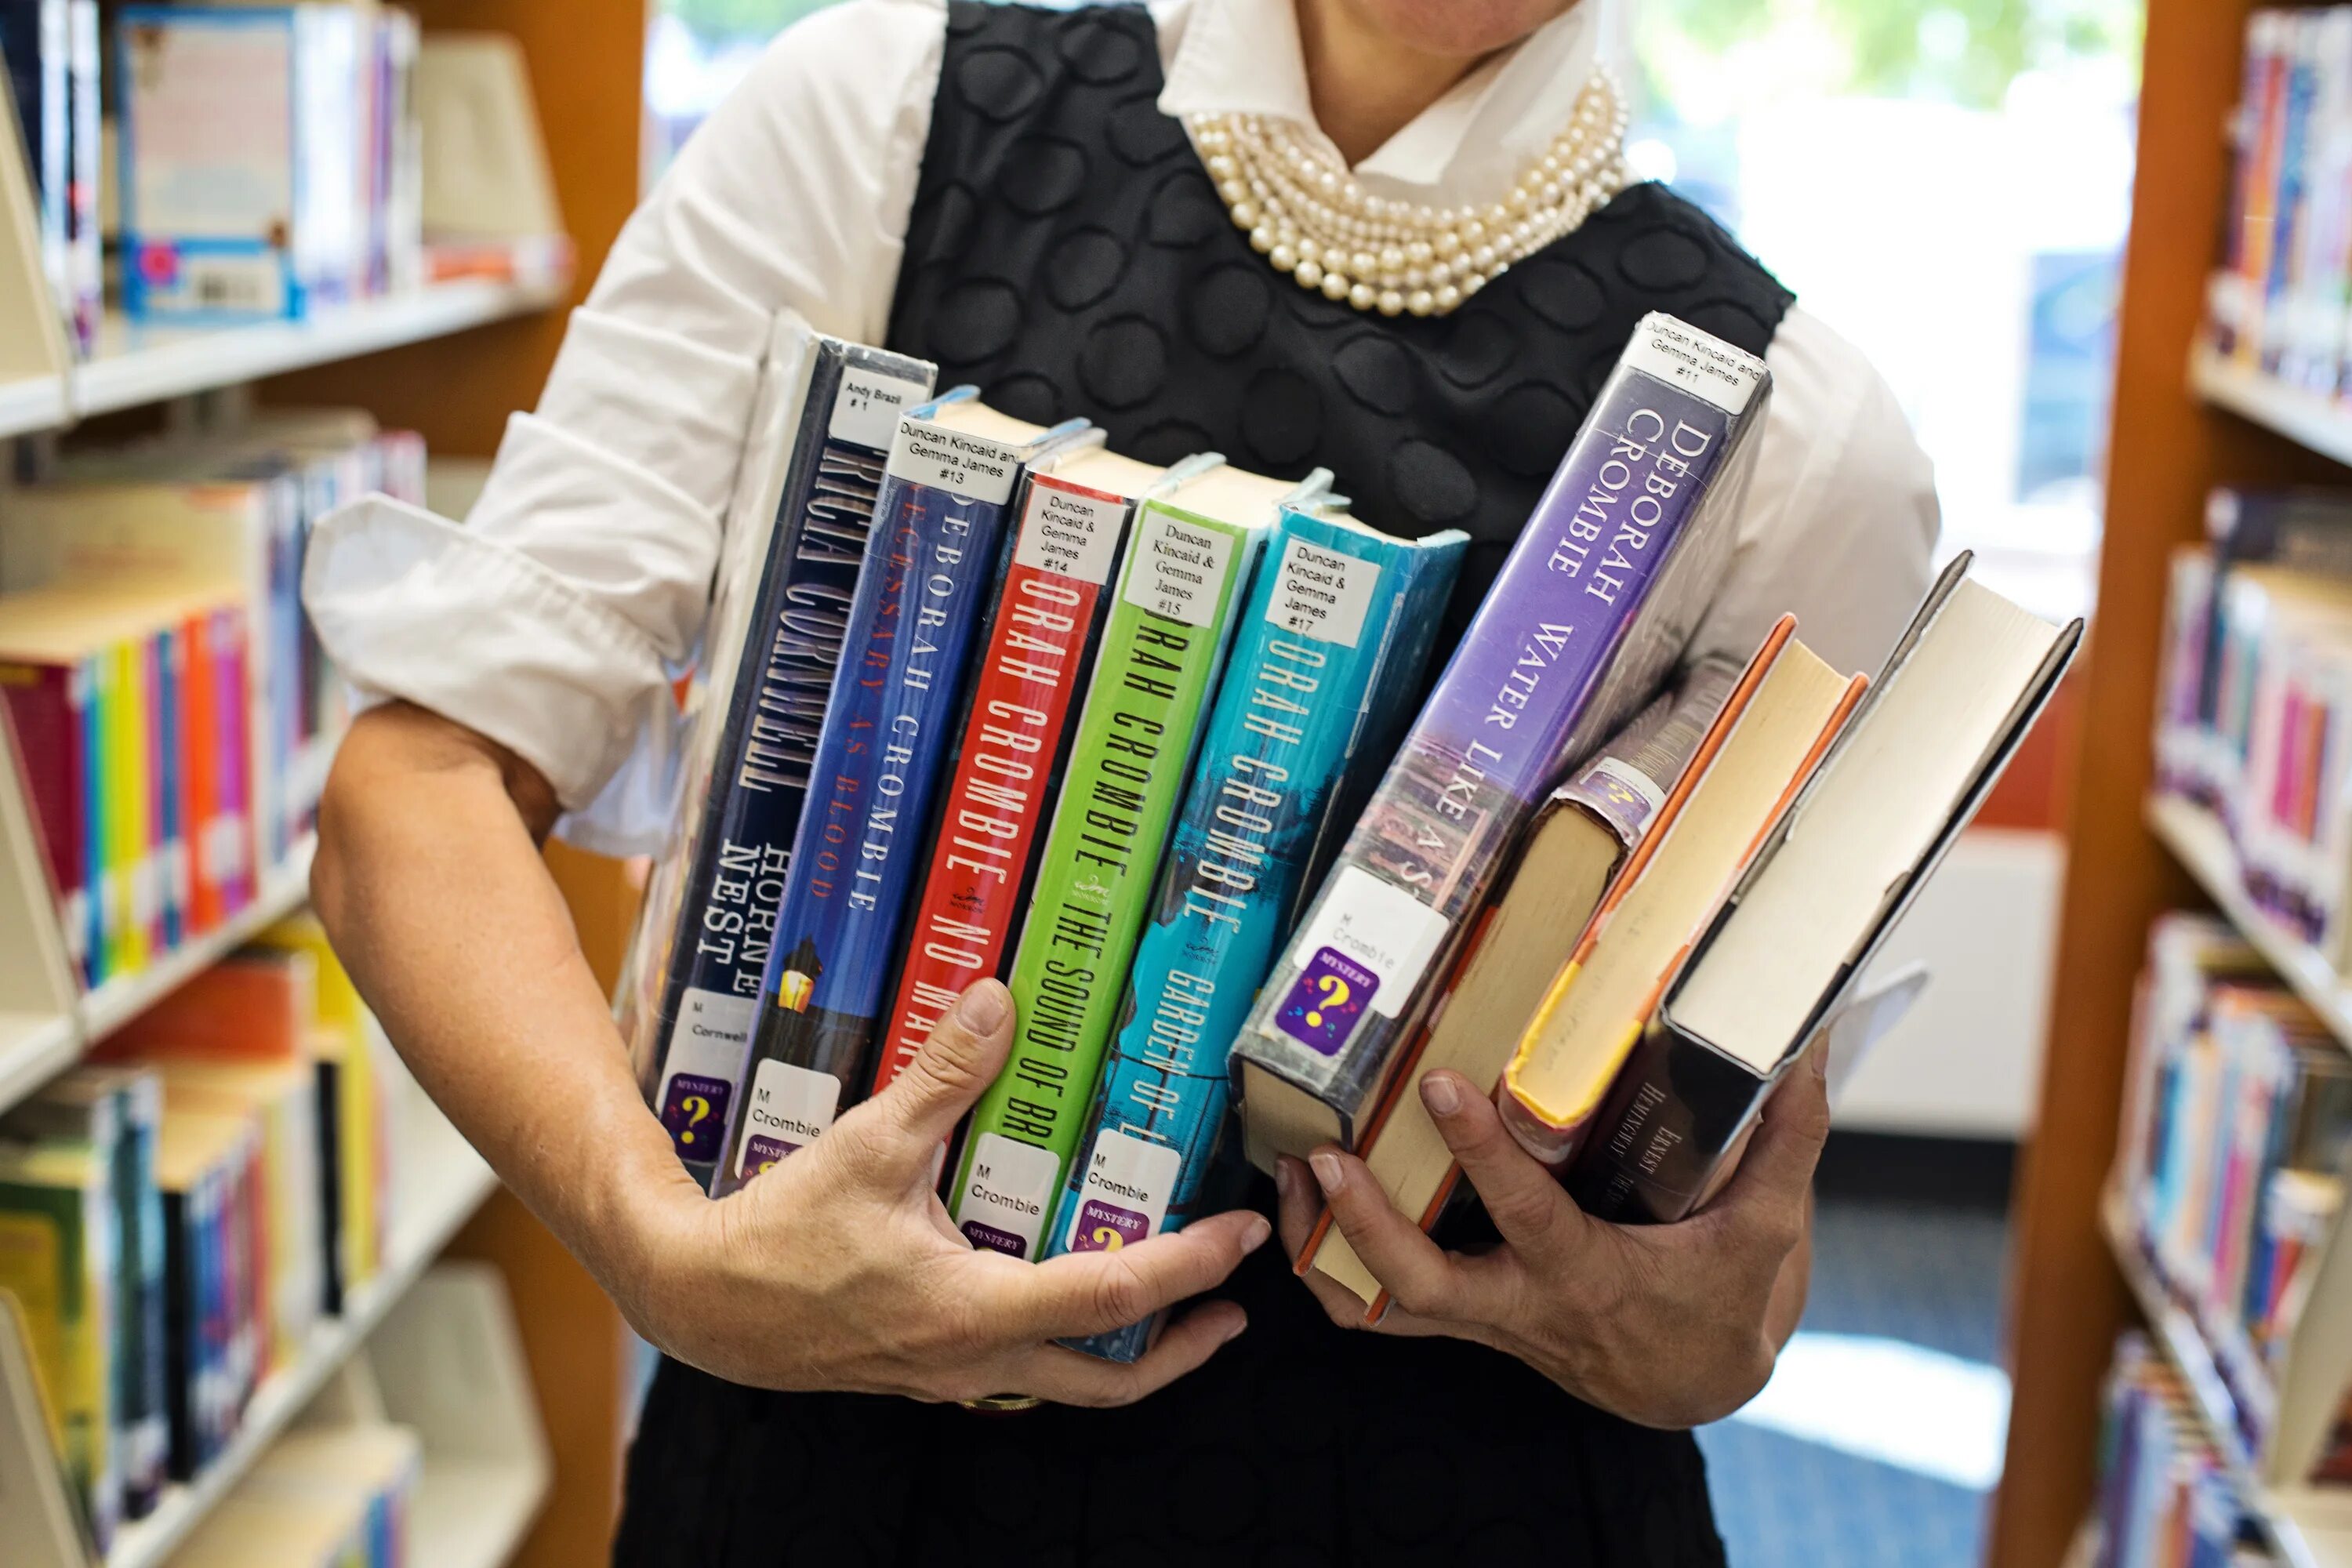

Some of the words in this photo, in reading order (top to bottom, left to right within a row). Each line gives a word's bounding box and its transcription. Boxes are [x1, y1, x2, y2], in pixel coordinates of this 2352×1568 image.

[1646, 321, 1690, 345] Duncan
[1693, 340, 1735, 367] Kincaid
[1737, 364, 1763, 381] and
[1651, 339, 1697, 366] Gemma
[1700, 362, 1739, 387] James
[1675, 366, 1700, 383] #11
[846, 383, 870, 401] Andy
[873, 389, 902, 405] Brazil
[900, 422, 946, 446] Duncan
[949, 434, 997, 459] Kincaid
[909, 442, 960, 466] Gemma
[963, 459, 1004, 478] James
[939, 468, 965, 485] #13
[797, 447, 889, 564] RICIA
[1050, 495, 1094, 517] Duncan
[1546, 407, 1664, 579] CROMBIE
[1041, 510, 1083, 530] Kincaid
[1086, 522, 1095, 533] &
[1584, 418, 1712, 607] DEBORAH
[1041, 525, 1087, 546] Gemma
[1041, 541, 1080, 560] James
[1165, 524, 1212, 550] Duncan
[1044, 557, 1069, 572] #14
[1153, 539, 1201, 564] Kincaid
[1203, 556, 1215, 569] &
[1297, 546, 1345, 572] Duncan
[1156, 560, 1203, 585] Gemma
[1287, 561, 1334, 586] Kincaid
[1336, 577, 1345, 590] &
[860, 484, 927, 695] ECESSARY
[1155, 579, 1193, 601] James
[1287, 579, 1337, 604] Gemma
[1158, 599, 1182, 615] #15
[1285, 597, 1327, 619] James
[998, 578, 1080, 687] ORAH
[1288, 615, 1315, 632] #17
[1123, 608, 1192, 701] RAH
[1484, 621, 1575, 731] WATER
[1242, 639, 1326, 746] ORAH
[946, 699, 1048, 885] CROMBIE
[1074, 710, 1166, 877] CROMBIE
[1436, 738, 1504, 822] LIKE
[848, 714, 920, 912] CROMBIE
[808, 774, 859, 898] BLOOD
[1183, 753, 1290, 934] CROMBIE
[1416, 824, 1446, 850] A
[697, 838, 762, 965] NEST
[1052, 902, 1112, 960] THE
[1341, 913, 1353, 925] M
[924, 913, 992, 970] NO
[1333, 927, 1395, 970] Crombie
[1319, 952, 1372, 988] MYSTERY
[693, 1001, 703, 1013] M
[1026, 960, 1095, 1053] SOUND
[692, 1024, 749, 1044] Cornwell
[1141, 968, 1215, 1080] GARDEN
[1014, 1057, 1069, 1098] OF
[757, 1087, 771, 1103] M
[1129, 1077, 1181, 1123] OF
[752, 1109, 821, 1138] Crombie
[1610, 1081, 1667, 1158] HEMINGWAY
[1094, 1153, 1108, 1168] M
[1639, 1126, 1683, 1174] ERNEST
[976, 1164, 991, 1180] M
[1088, 1171, 1150, 1203] Crombie
[971, 1184, 1040, 1216] Crombie
[1086, 1205, 1142, 1230] MYSTERY
[969, 1225, 1021, 1250] MYSTERY
